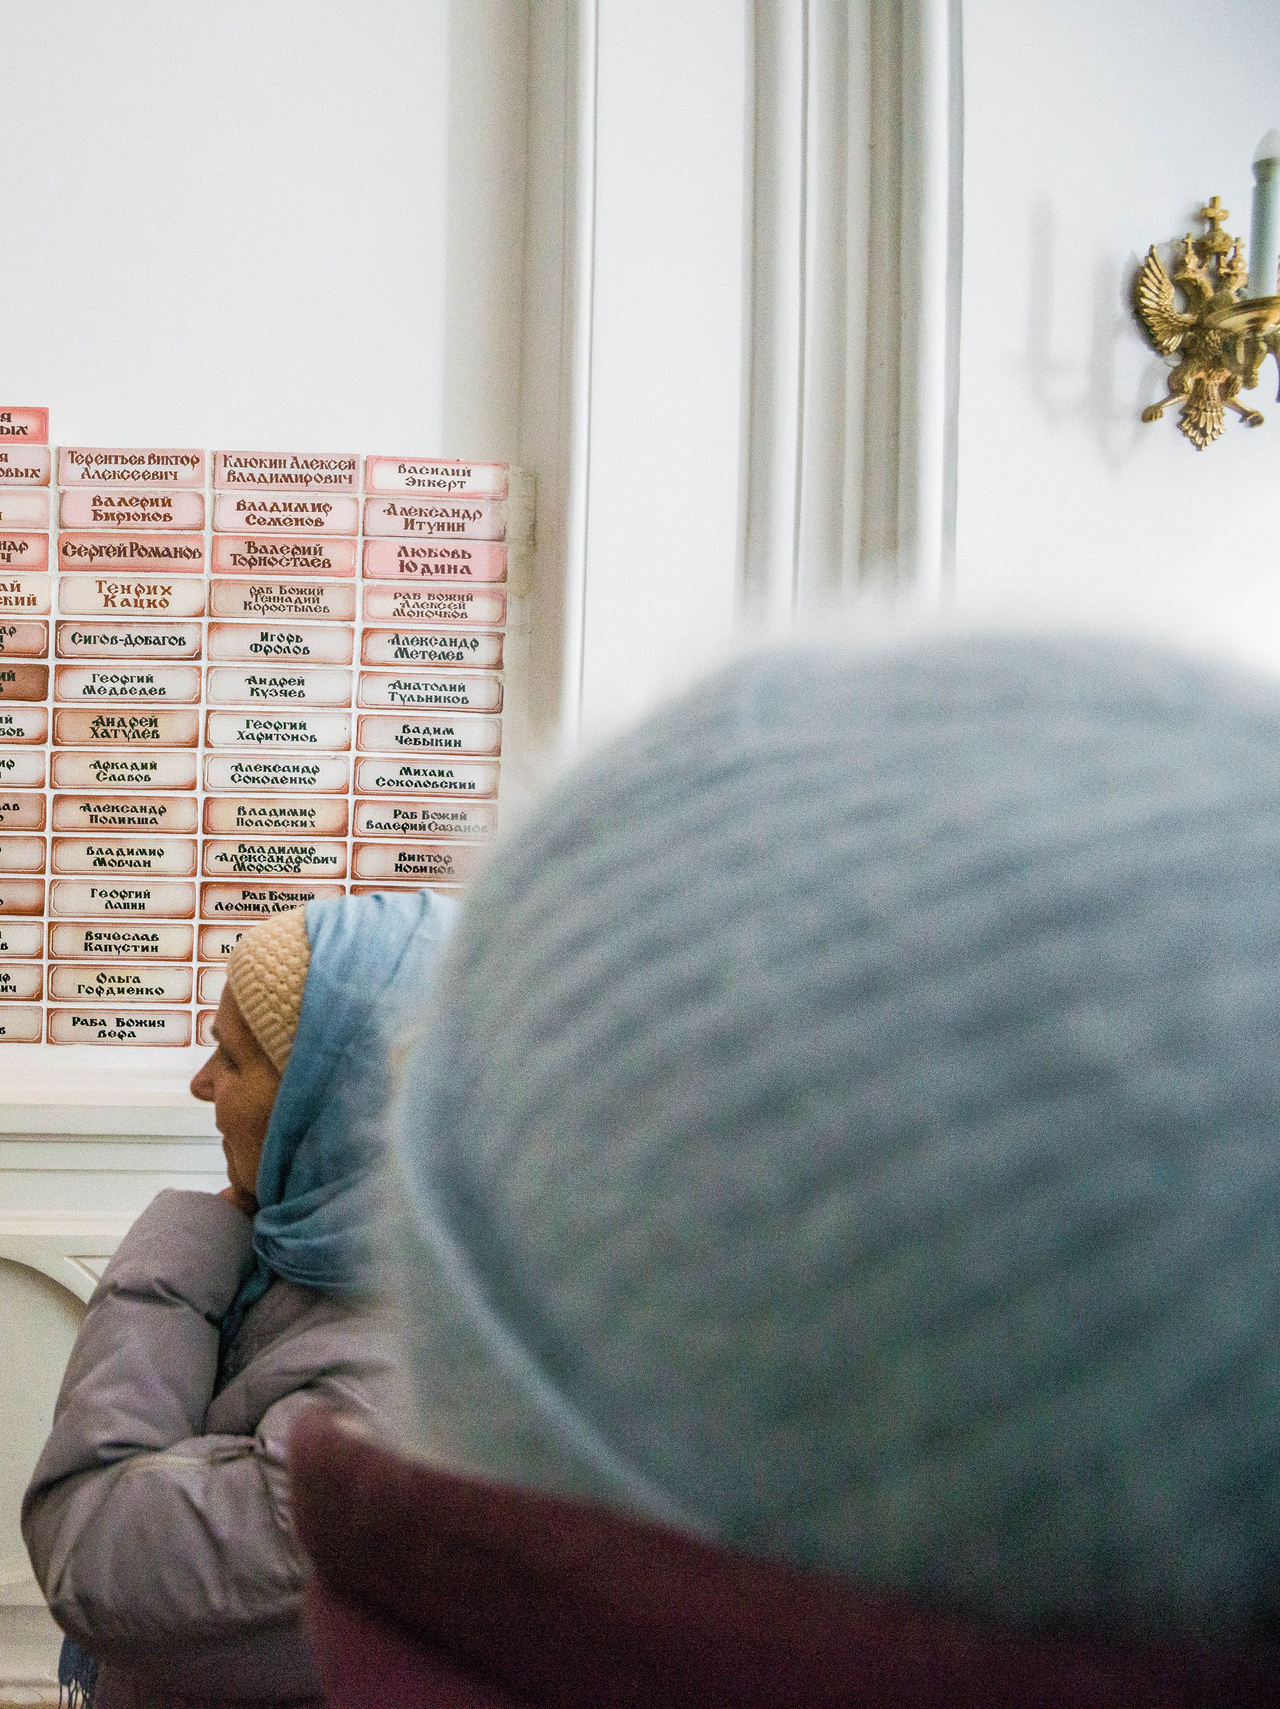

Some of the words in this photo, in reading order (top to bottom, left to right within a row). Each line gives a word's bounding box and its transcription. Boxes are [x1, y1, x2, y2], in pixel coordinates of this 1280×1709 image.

[69, 451, 146, 467] Терентьев
[148, 452, 200, 470] Виктор
[223, 455, 286, 470] Клюкин
[290, 455, 356, 471] Алексей
[81, 468, 178, 482] Алексеевич
[398, 463, 472, 478] Василий
[226, 469, 353, 486] Владимирович
[405, 476, 466, 492] Эккерт
[92, 495, 172, 512] Валерий
[236, 499, 332, 517] Владимир
[92, 509, 173, 525] Бирюков
[383, 503, 483, 523] Александр
[403, 517, 466, 534] Итунин
[62, 541, 128, 562] Сергей
[129, 541, 202, 560] Романов
[245, 541, 323, 557] Валерий
[397, 545, 472, 559] Любовь
[399, 559, 473, 576] Юдина
[104, 594, 170, 610] Кацко
[260, 631, 303, 643] Игорь
[387, 633, 479, 651] Александр
[249, 643, 310, 656] Фролов
[394, 647, 464, 661] Метелев
[92, 673, 154, 686] Георгий
[245, 675, 305, 688] Андрей
[82, 685, 166, 697] Медведев
[249, 686, 306, 699] Кузяев
[388, 680, 466, 693] Анатолий
[388, 691, 469, 705] Тульников
[92, 715, 158, 728] Андрей
[245, 719, 307, 732] Георгий
[90, 727, 160, 742] Хатулев
[401, 724, 454, 736] Вадим
[236, 730, 318, 744] Харитонов
[395, 735, 462, 748] Чебыкин
[89, 760, 158, 773] Аркадий
[230, 762, 320, 775] Александр
[399, 767, 454, 778] Михаил
[96, 770, 151, 783] Славов
[230, 773, 317, 786] Соколенко
[375, 776, 476, 790] Соколовский
[79, 803, 167, 816] Александр
[237, 806, 316, 819] Владимир
[89, 814, 158, 826] Поликша
[236, 817, 316, 829] Половских
[86, 846, 165, 859] Владимир
[238, 844, 316, 856] Владимир
[92, 857, 151, 868] Мовчан
[215, 853, 338, 865] Александрович
[398, 852, 453, 865] Виктор
[233, 862, 301, 874] Морозов
[90, 888, 151, 901] Георгий
[85, 930, 159, 942] Вячеслав
[84, 942, 159, 955] Капустин
[96, 972, 141, 985] Ольга
[77, 984, 165, 997] Гордиенко
[72, 1016, 107, 1028] Раба
[115, 1017, 166, 1028] Божия
